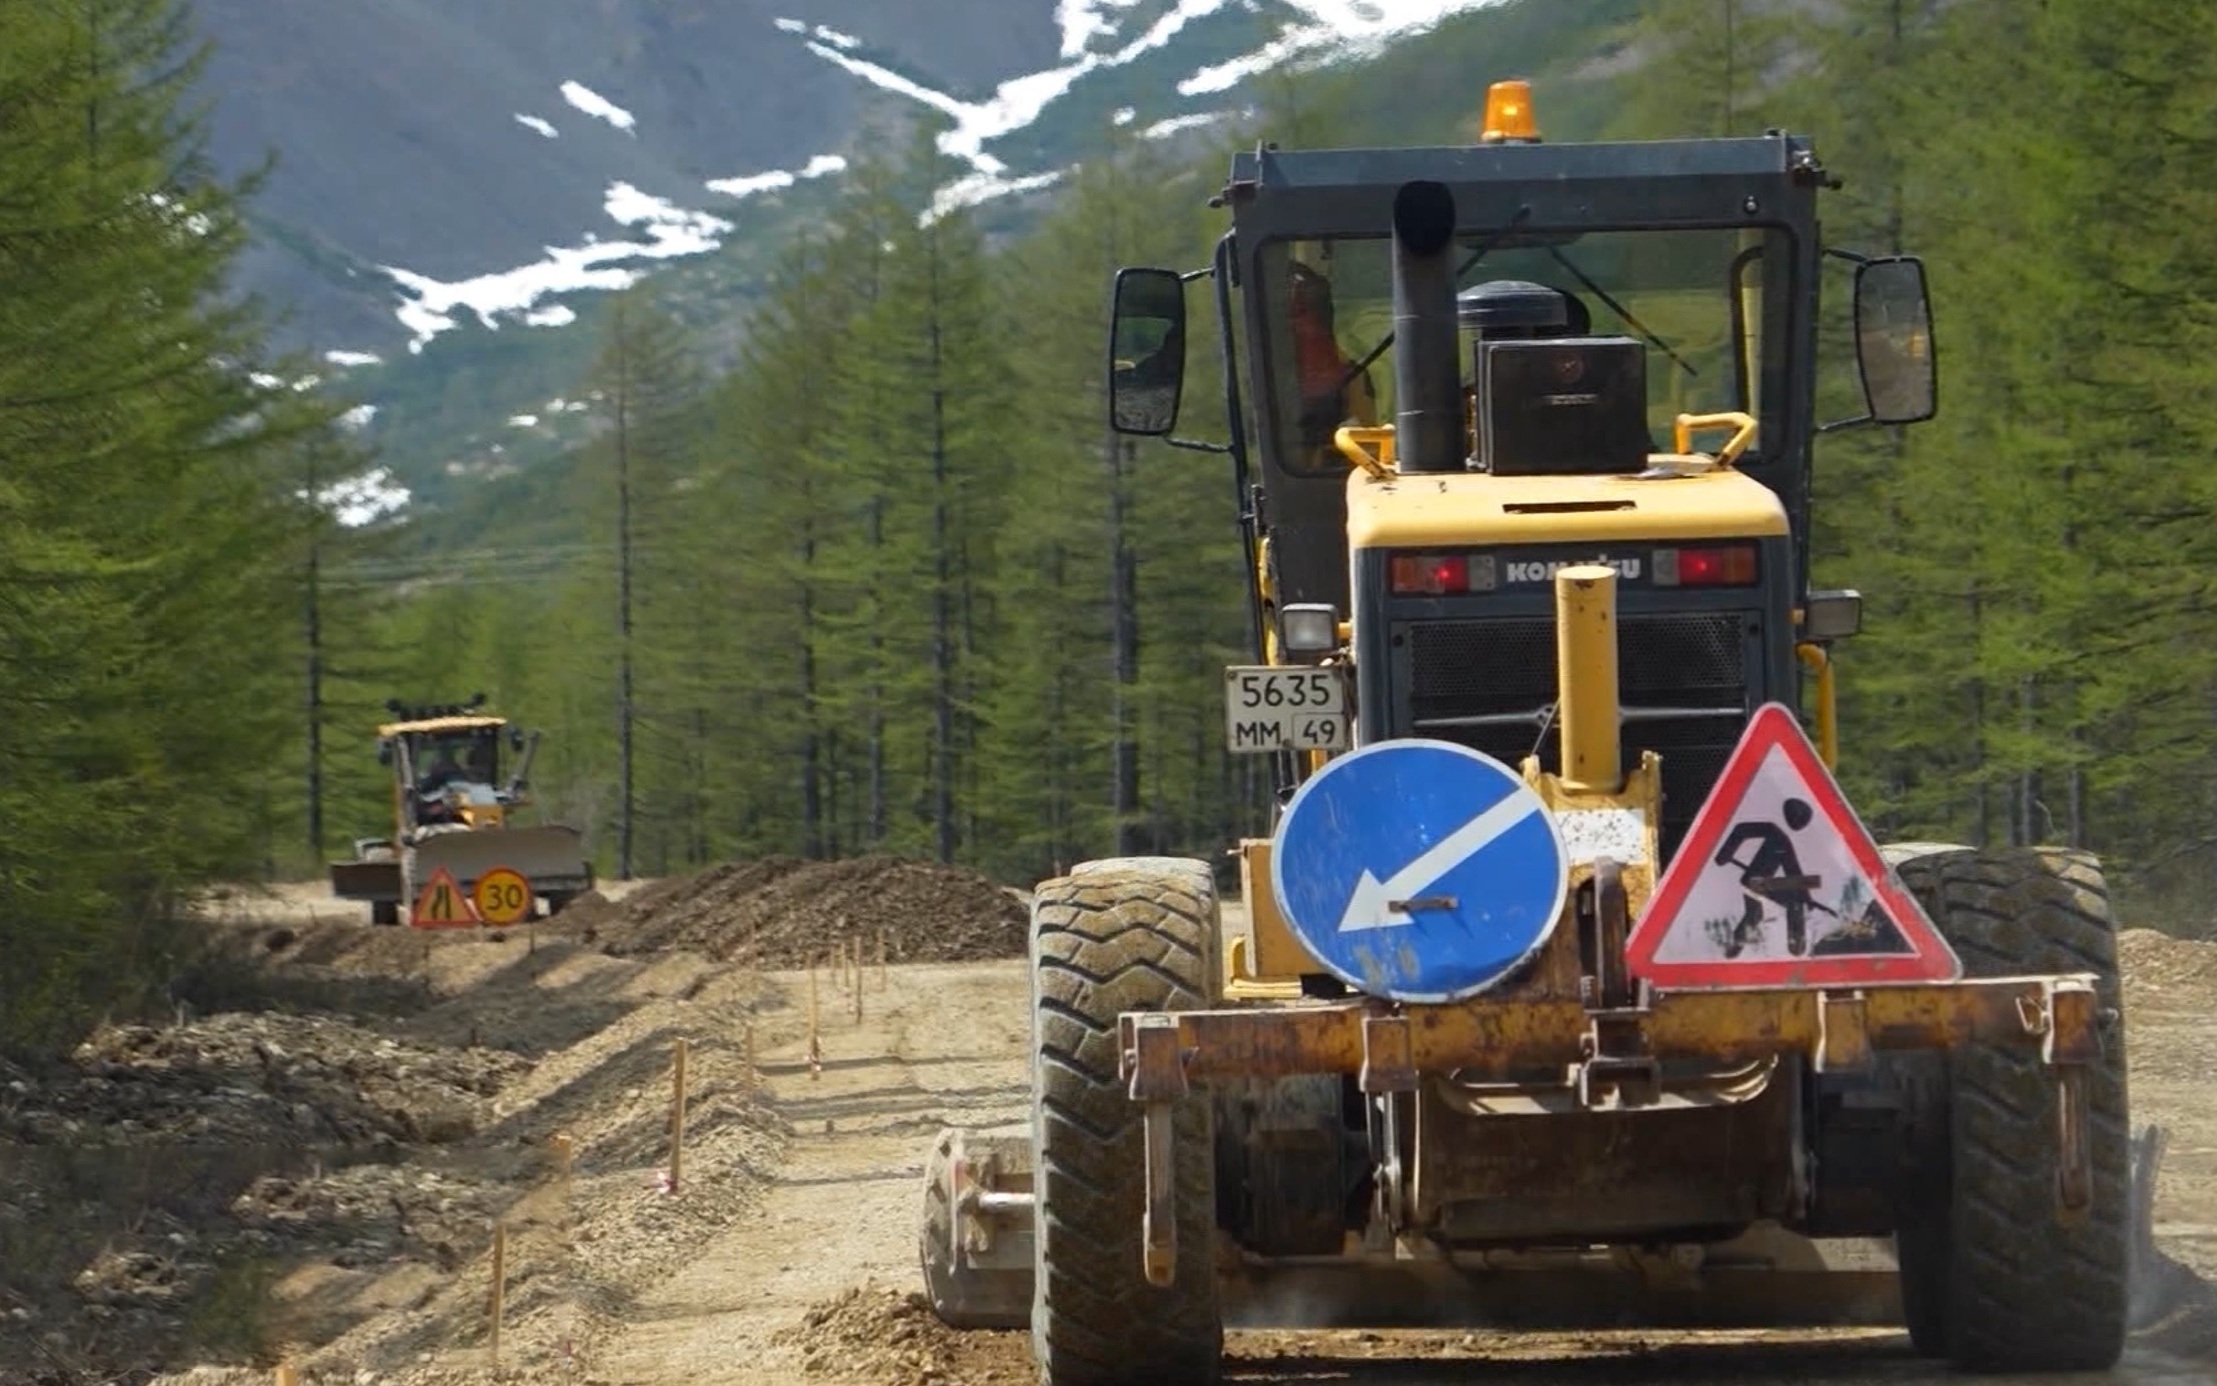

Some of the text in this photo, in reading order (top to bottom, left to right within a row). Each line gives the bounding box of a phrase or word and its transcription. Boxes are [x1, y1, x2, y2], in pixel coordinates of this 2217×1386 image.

[1242, 674, 1330, 707] 5635
[1236, 719, 1336, 747] MM 49
[486, 884, 523, 911] 30
